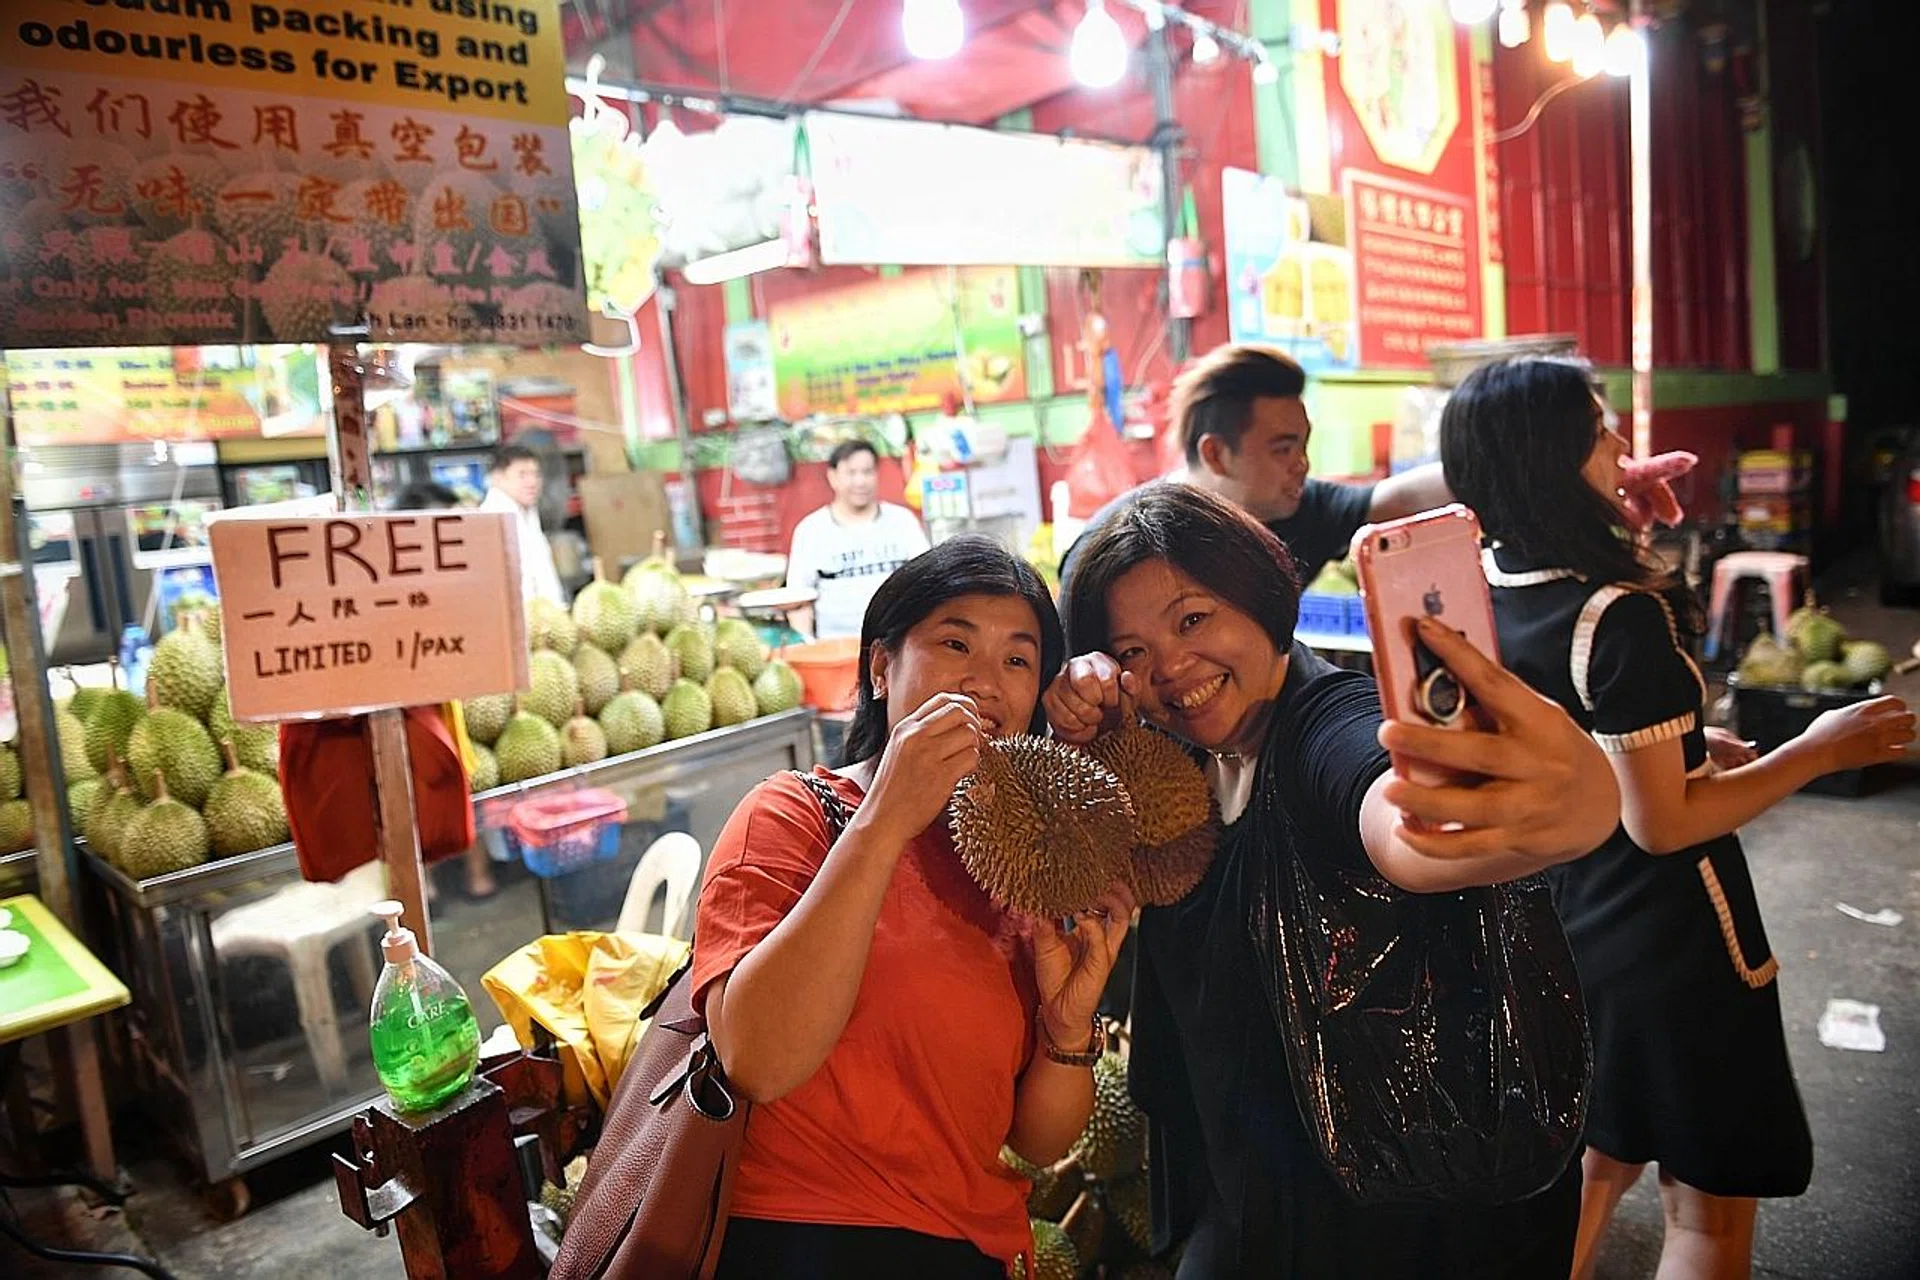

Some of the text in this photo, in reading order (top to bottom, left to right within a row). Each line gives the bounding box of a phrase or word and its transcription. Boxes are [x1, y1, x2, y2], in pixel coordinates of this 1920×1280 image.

[19, 20, 528, 104] odourless for Export
[252, 4, 440, 58] packing
[456, 35, 529, 66] and
[267, 516, 468, 589] FREE
[254, 641, 372, 679] LIMITED
